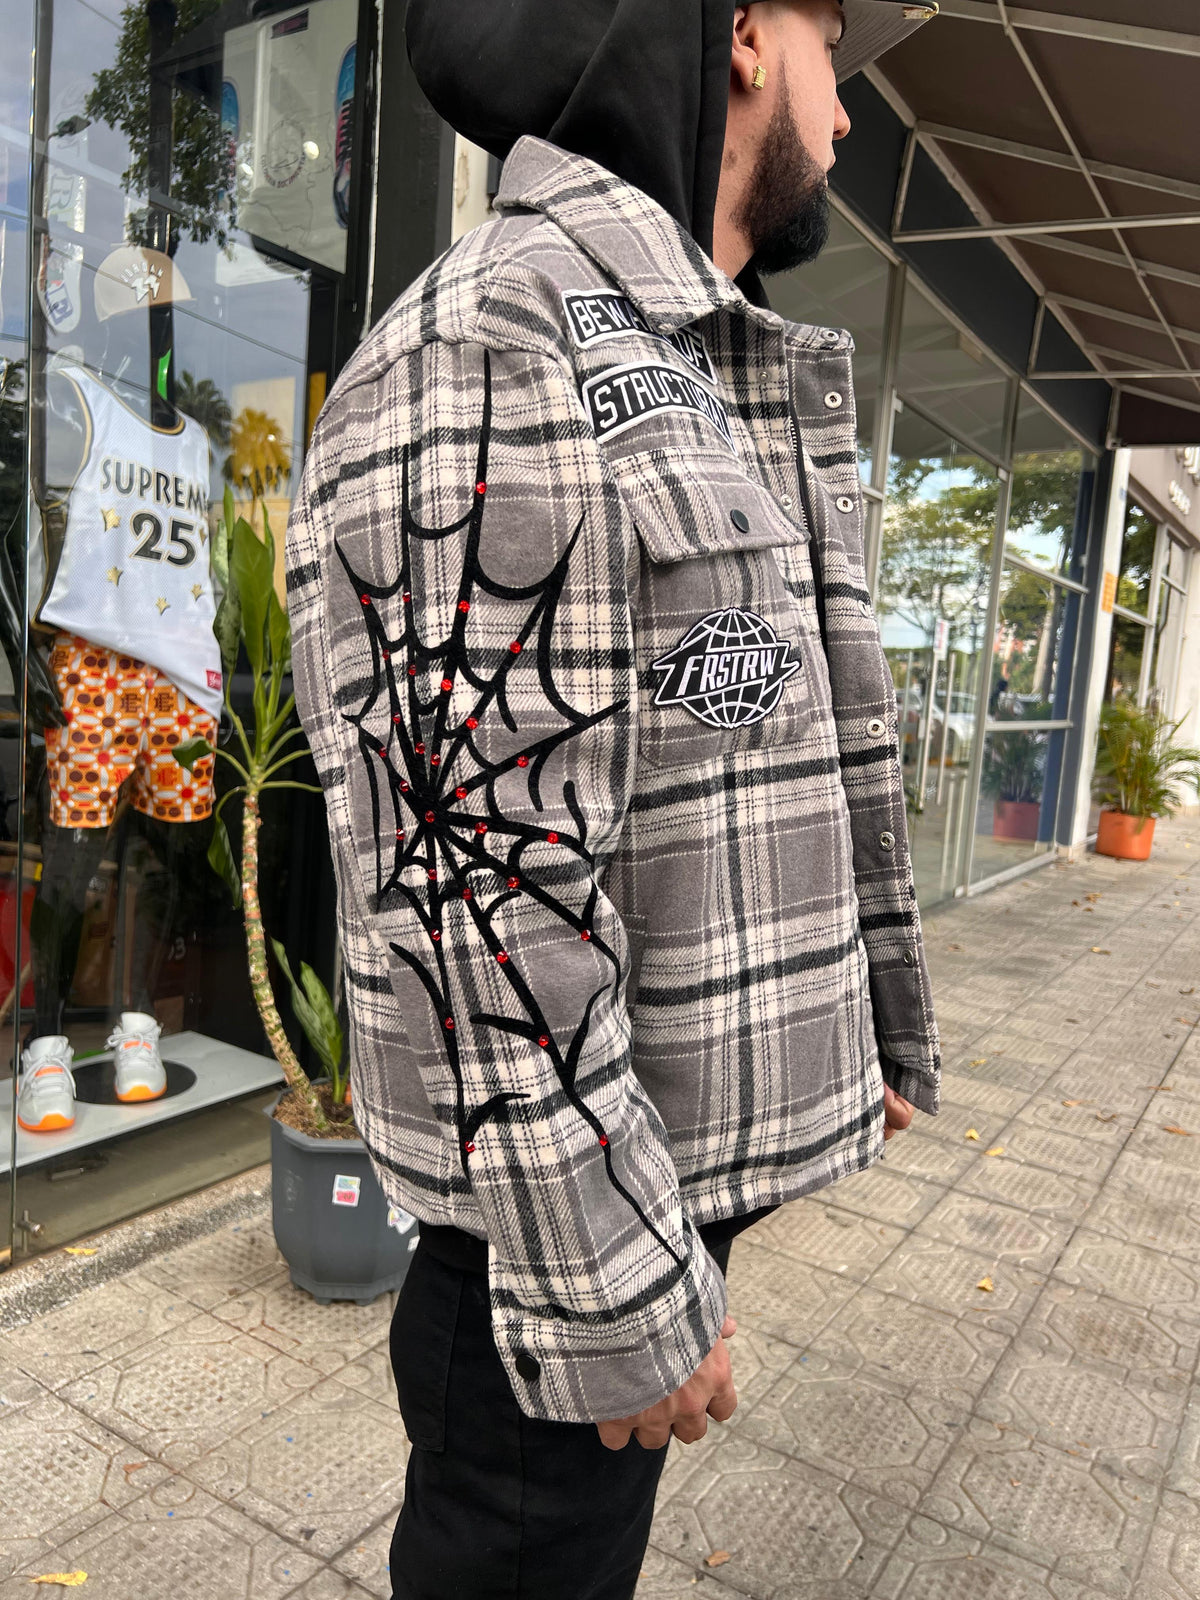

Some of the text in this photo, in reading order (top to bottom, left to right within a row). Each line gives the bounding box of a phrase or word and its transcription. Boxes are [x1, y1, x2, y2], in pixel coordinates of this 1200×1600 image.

[570, 297, 657, 341] BEWA
[594, 370, 732, 443] STRUCTURAL
[101, 456, 208, 510] SUPREM
[130, 511, 197, 568] 25
[676, 649, 778, 697] FRSTRW
